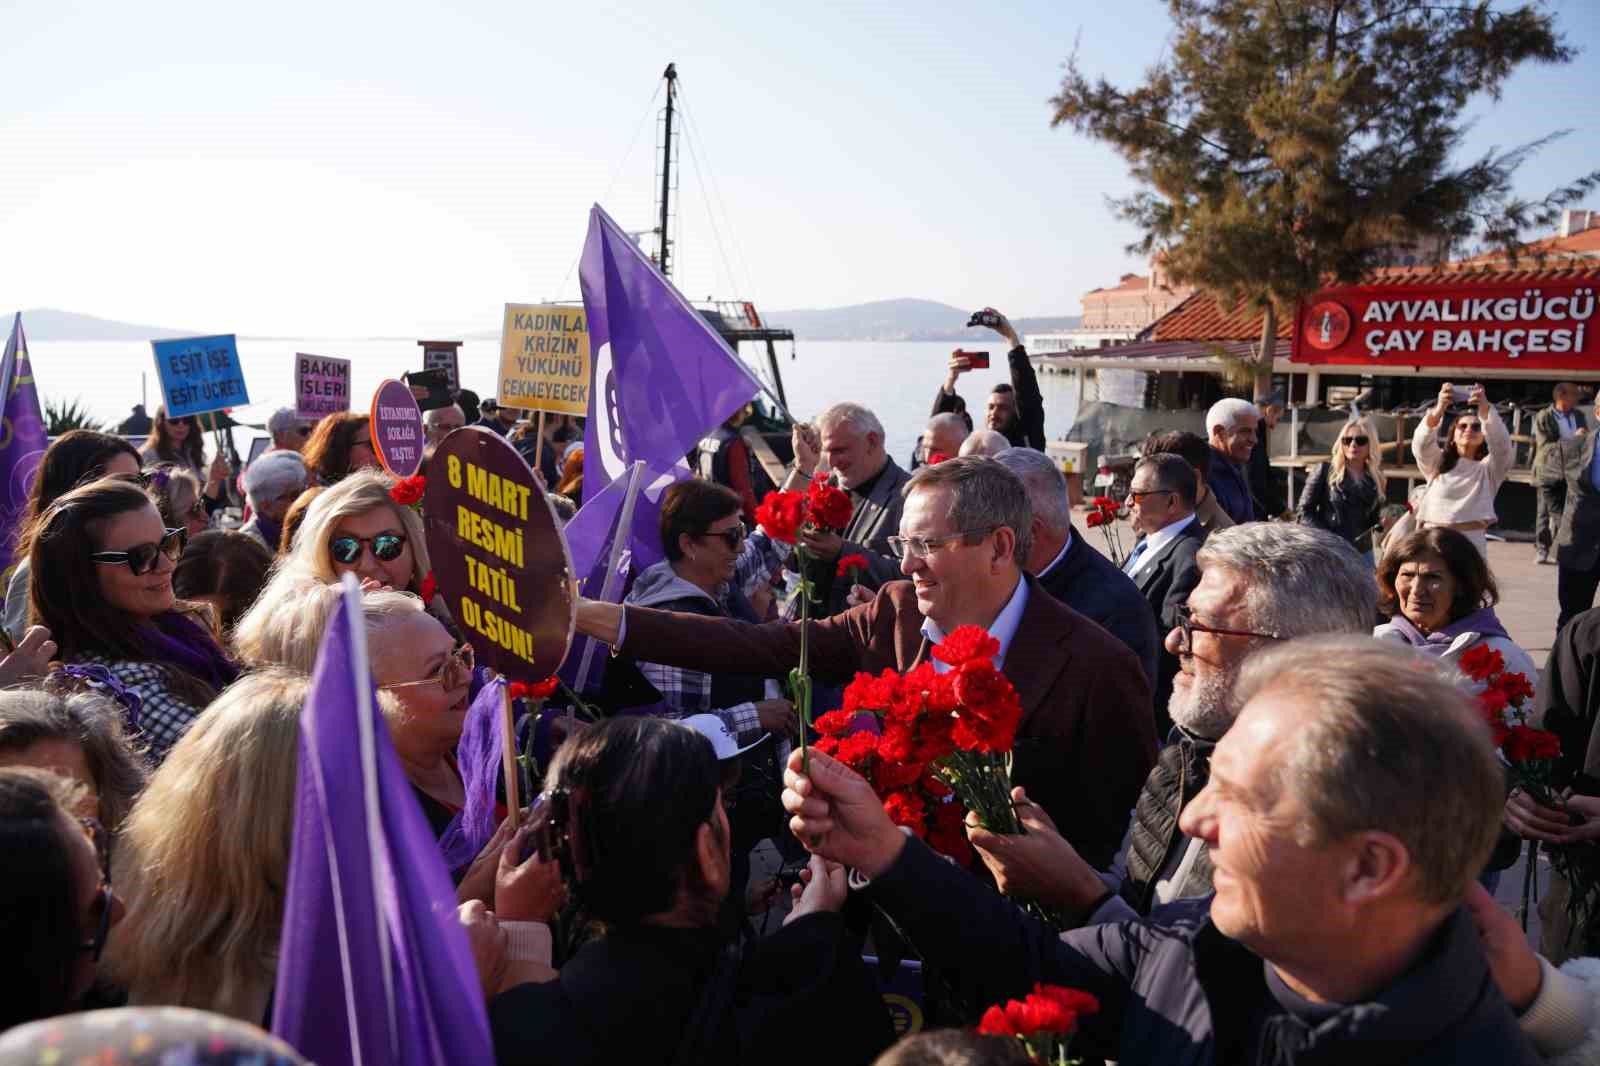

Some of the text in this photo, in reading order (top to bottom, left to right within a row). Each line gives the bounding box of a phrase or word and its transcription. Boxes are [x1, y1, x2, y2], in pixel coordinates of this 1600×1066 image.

[1362, 288, 1595, 322] AYVALIKGÜCÜ
[513, 313, 588, 333] KADINLA
[525, 332, 579, 354] KRİZİN
[1365, 323, 1585, 358] ÇAY BAHÇESİ
[170, 348, 202, 378] EŞİT
[300, 359, 348, 377] BAKIM
[517, 353, 582, 377] YÜKÜNÜ
[170, 382, 199, 406] EŞİT
[447, 454, 531, 521] 8 MART
[457, 504, 525, 568] RESMİ
[464, 554, 522, 613] TATİL
[461, 596, 535, 665] OLSUN!
